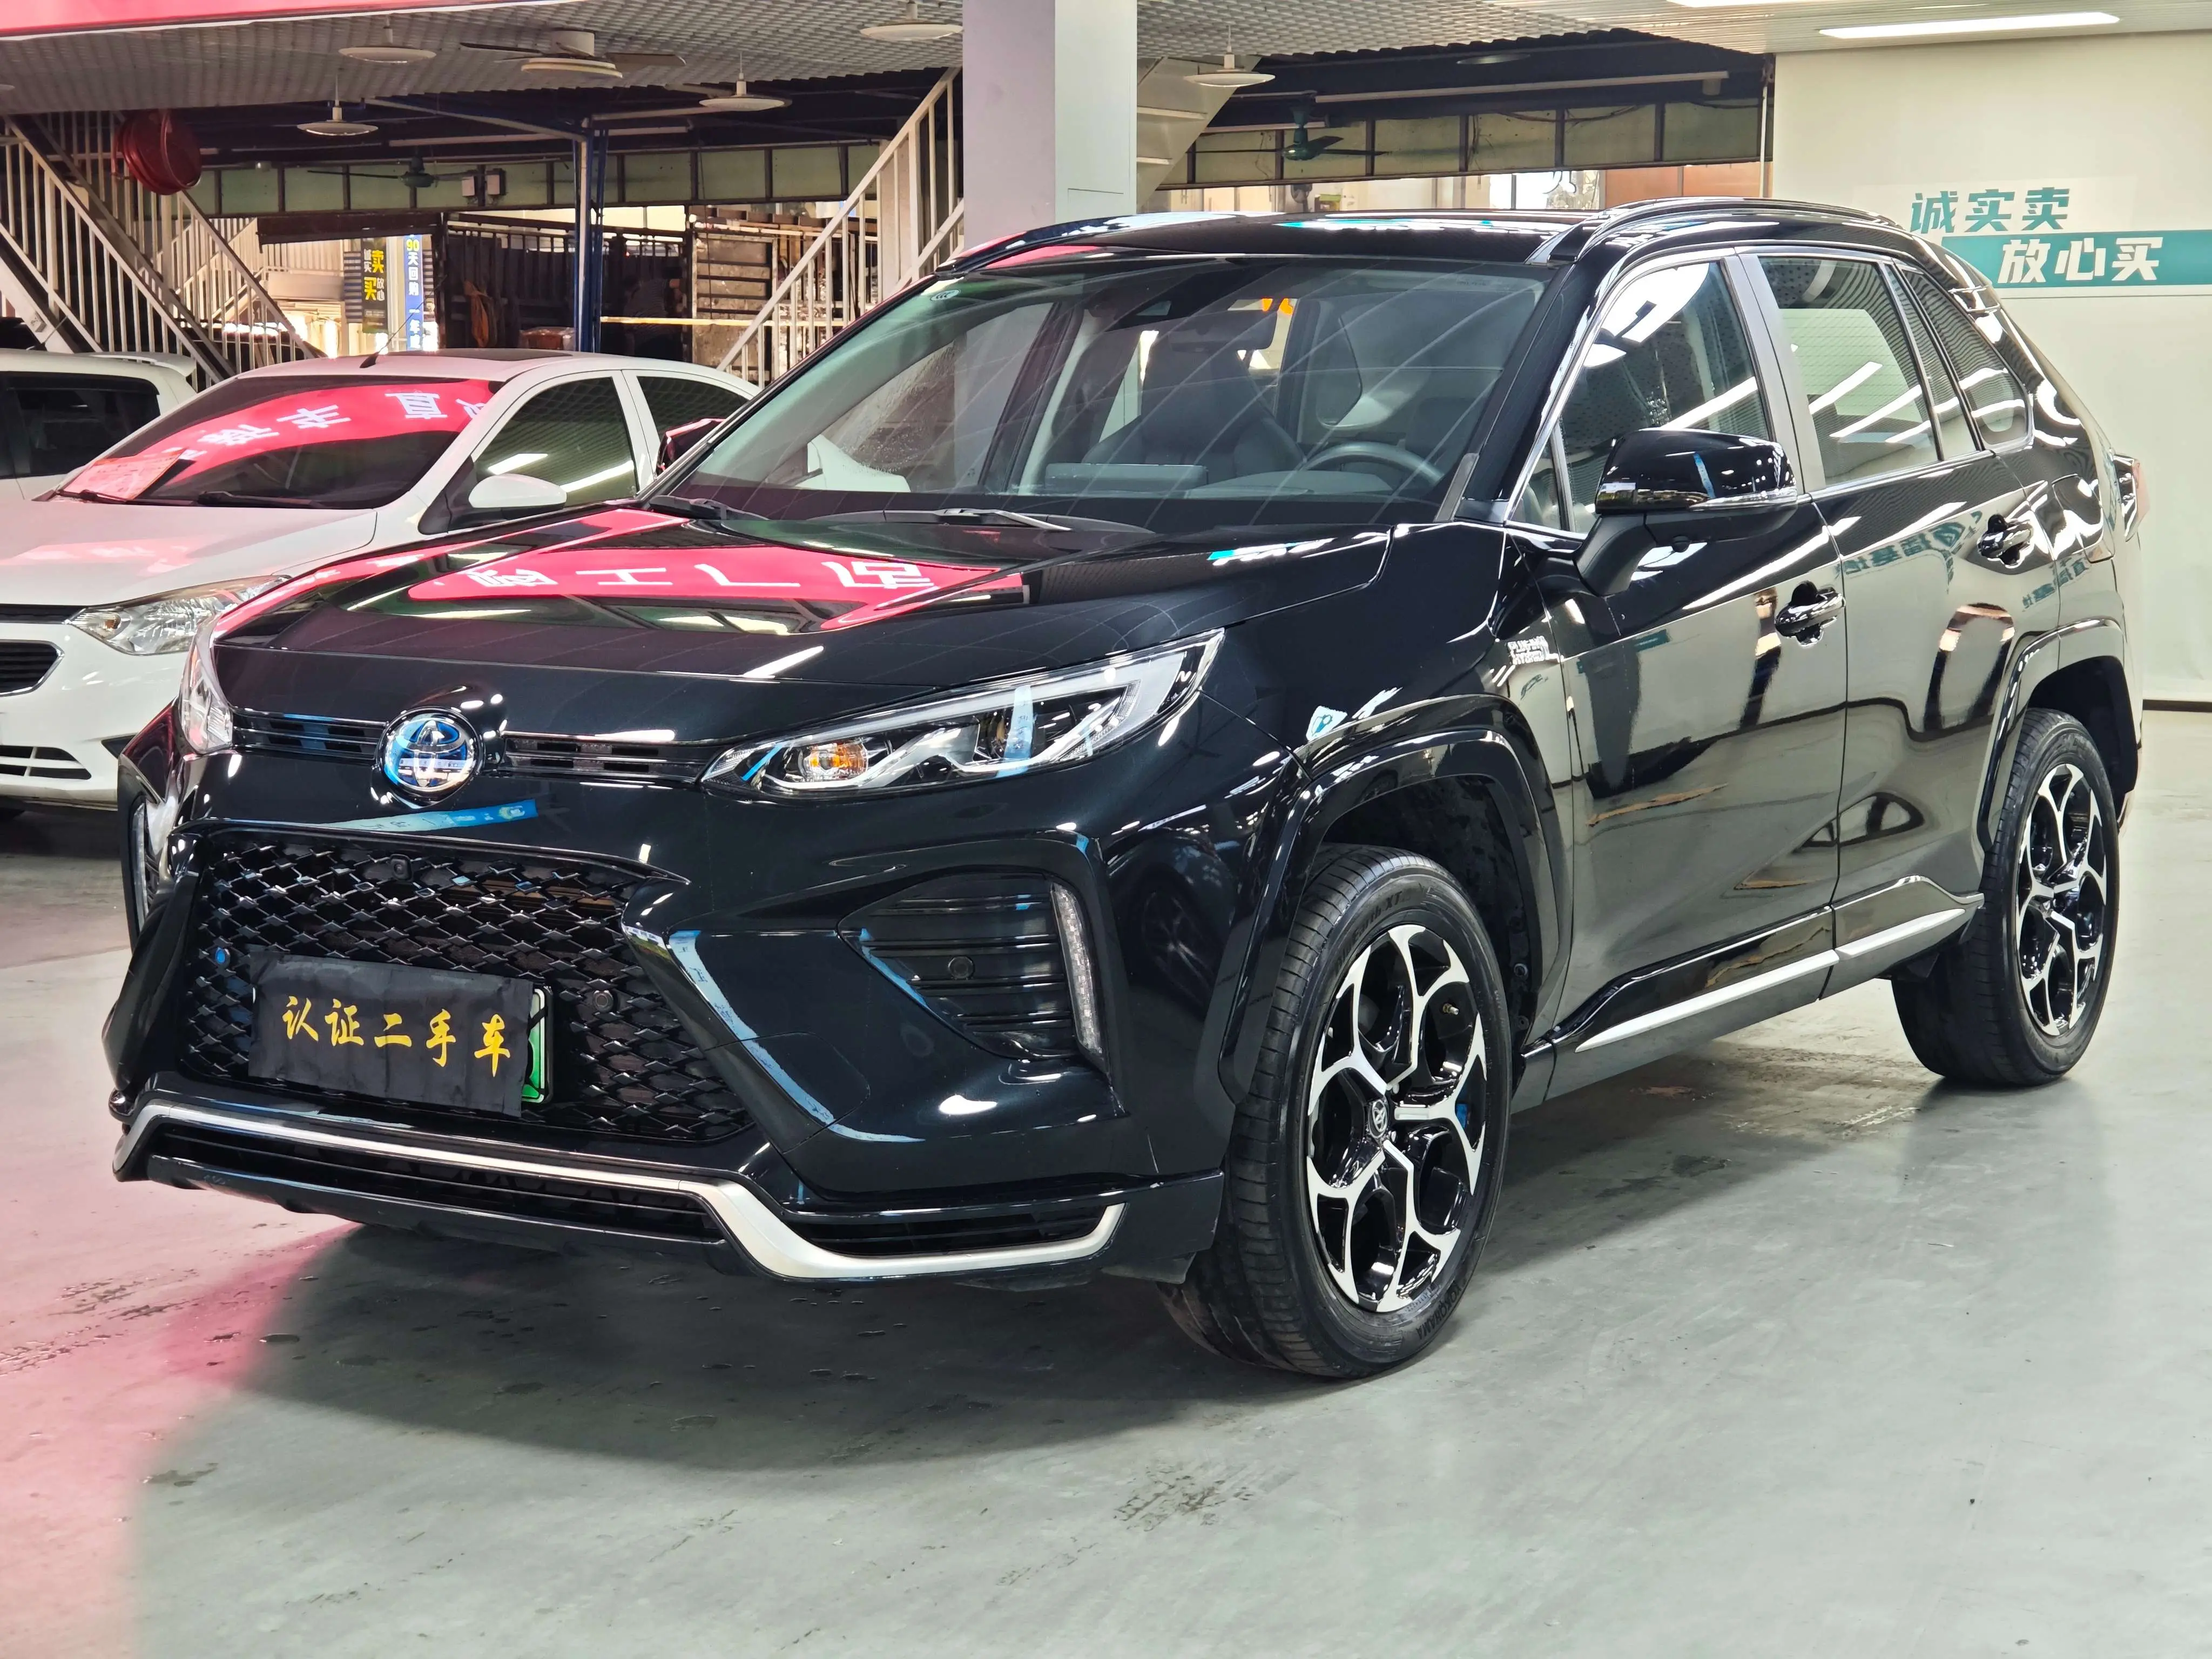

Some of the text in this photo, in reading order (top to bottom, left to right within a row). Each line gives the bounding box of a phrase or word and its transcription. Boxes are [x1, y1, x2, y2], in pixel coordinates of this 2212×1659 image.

[1910, 186, 2071, 234] 诚实卖
[406, 234, 420, 296] 90天回购
[1997, 237, 2164, 284] 放心买
[281, 995, 511, 1078] 认证二手车
